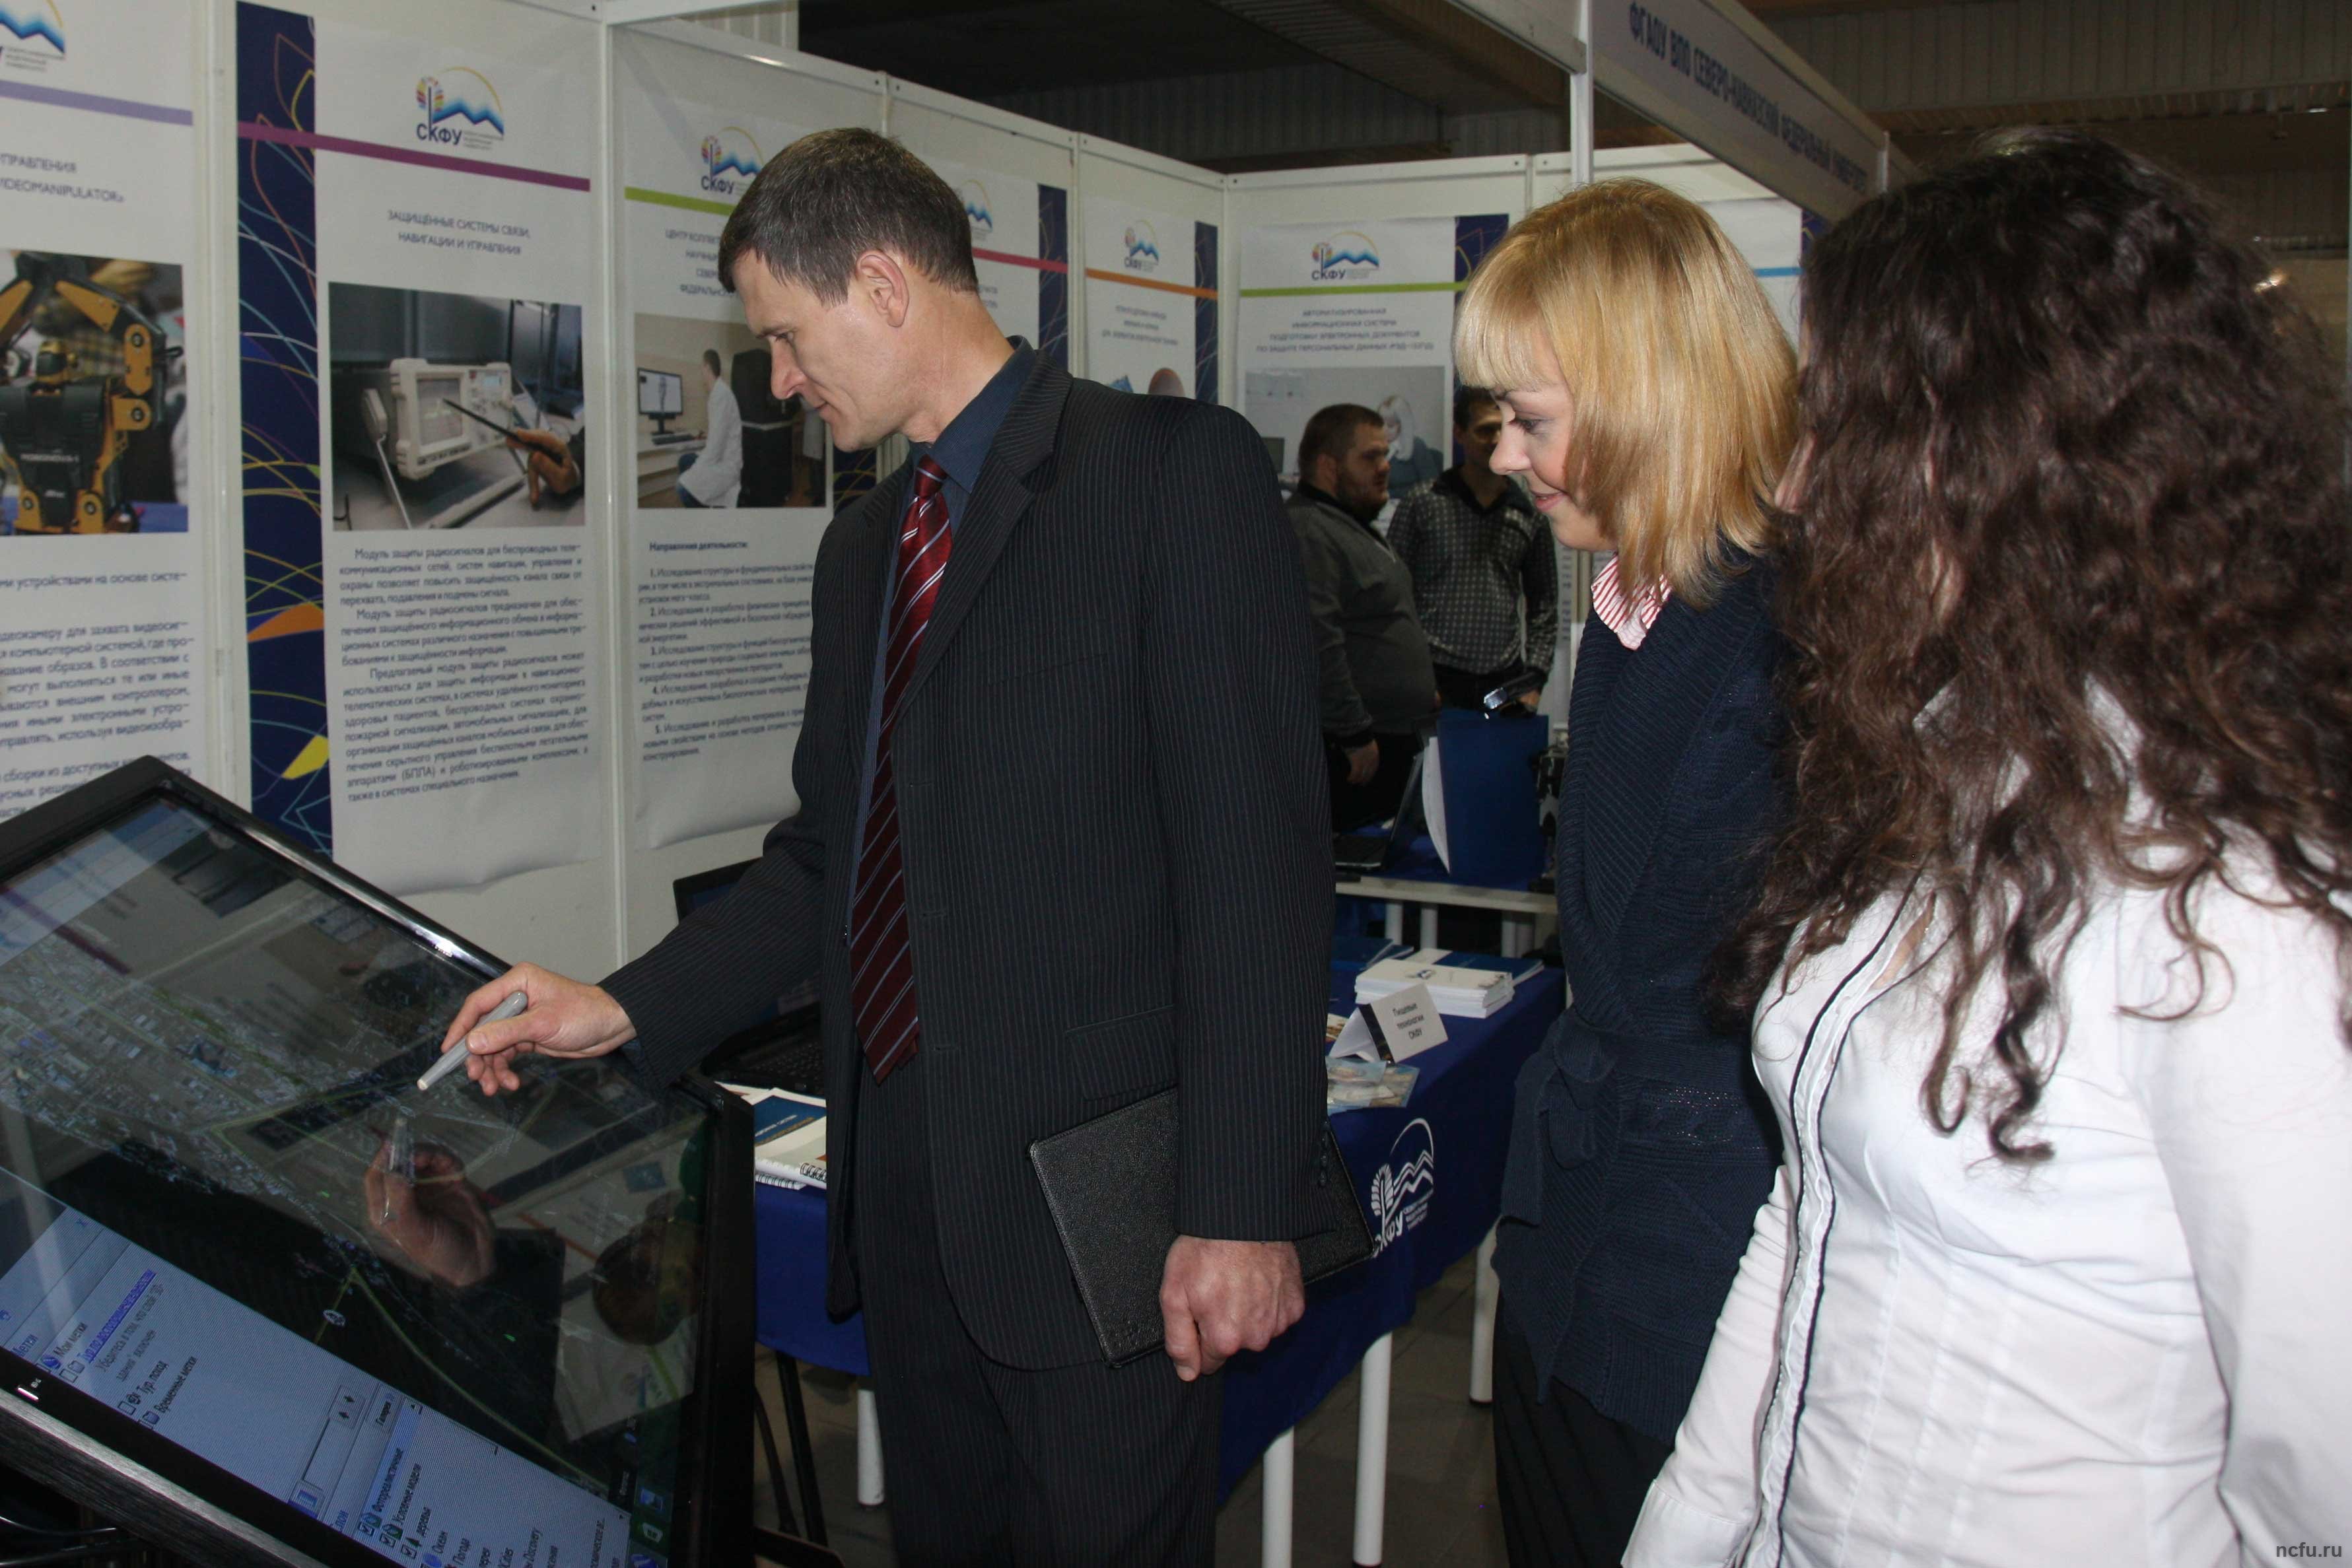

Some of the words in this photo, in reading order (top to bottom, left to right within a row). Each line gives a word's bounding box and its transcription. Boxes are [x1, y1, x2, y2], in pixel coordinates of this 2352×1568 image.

[417, 123, 462, 145] СКФУ
[701, 174, 735, 195] СКФУ
[457, 219, 500, 234] СИСТЕМЫ
[1311, 269, 1346, 281] СКФУ
[355, 549, 390, 561] Модуль
[357, 609, 391, 621] Модуль
